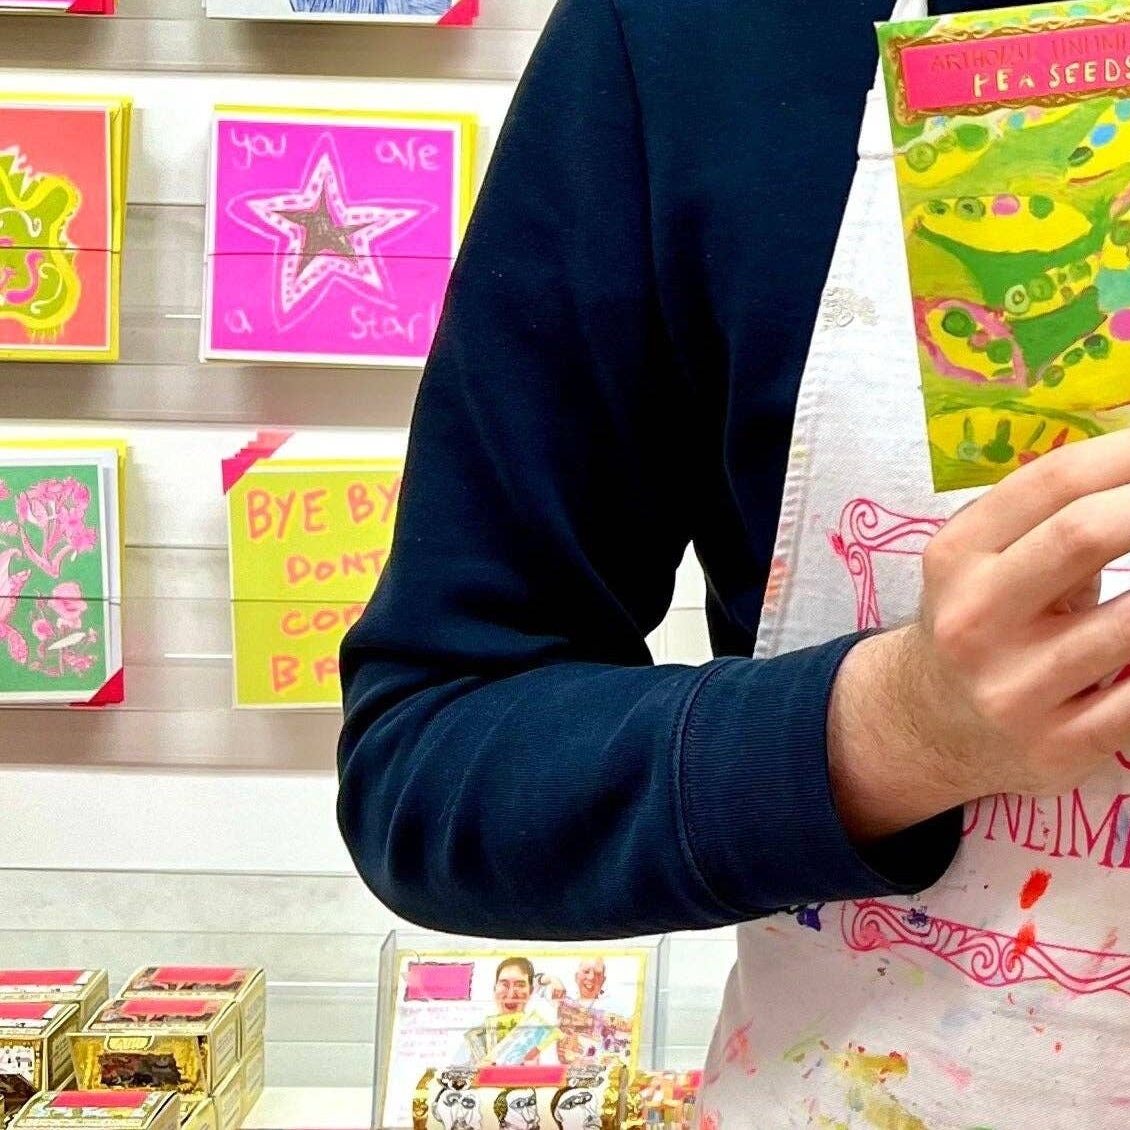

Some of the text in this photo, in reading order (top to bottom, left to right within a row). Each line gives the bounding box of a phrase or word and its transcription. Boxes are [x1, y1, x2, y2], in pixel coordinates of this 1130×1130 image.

[973, 68, 1035, 98] PEA
[375, 137, 441, 171] are
[224, 309, 253, 334] a
[246, 476, 401, 541] BYE BY
[285, 550, 386, 585] DONT
